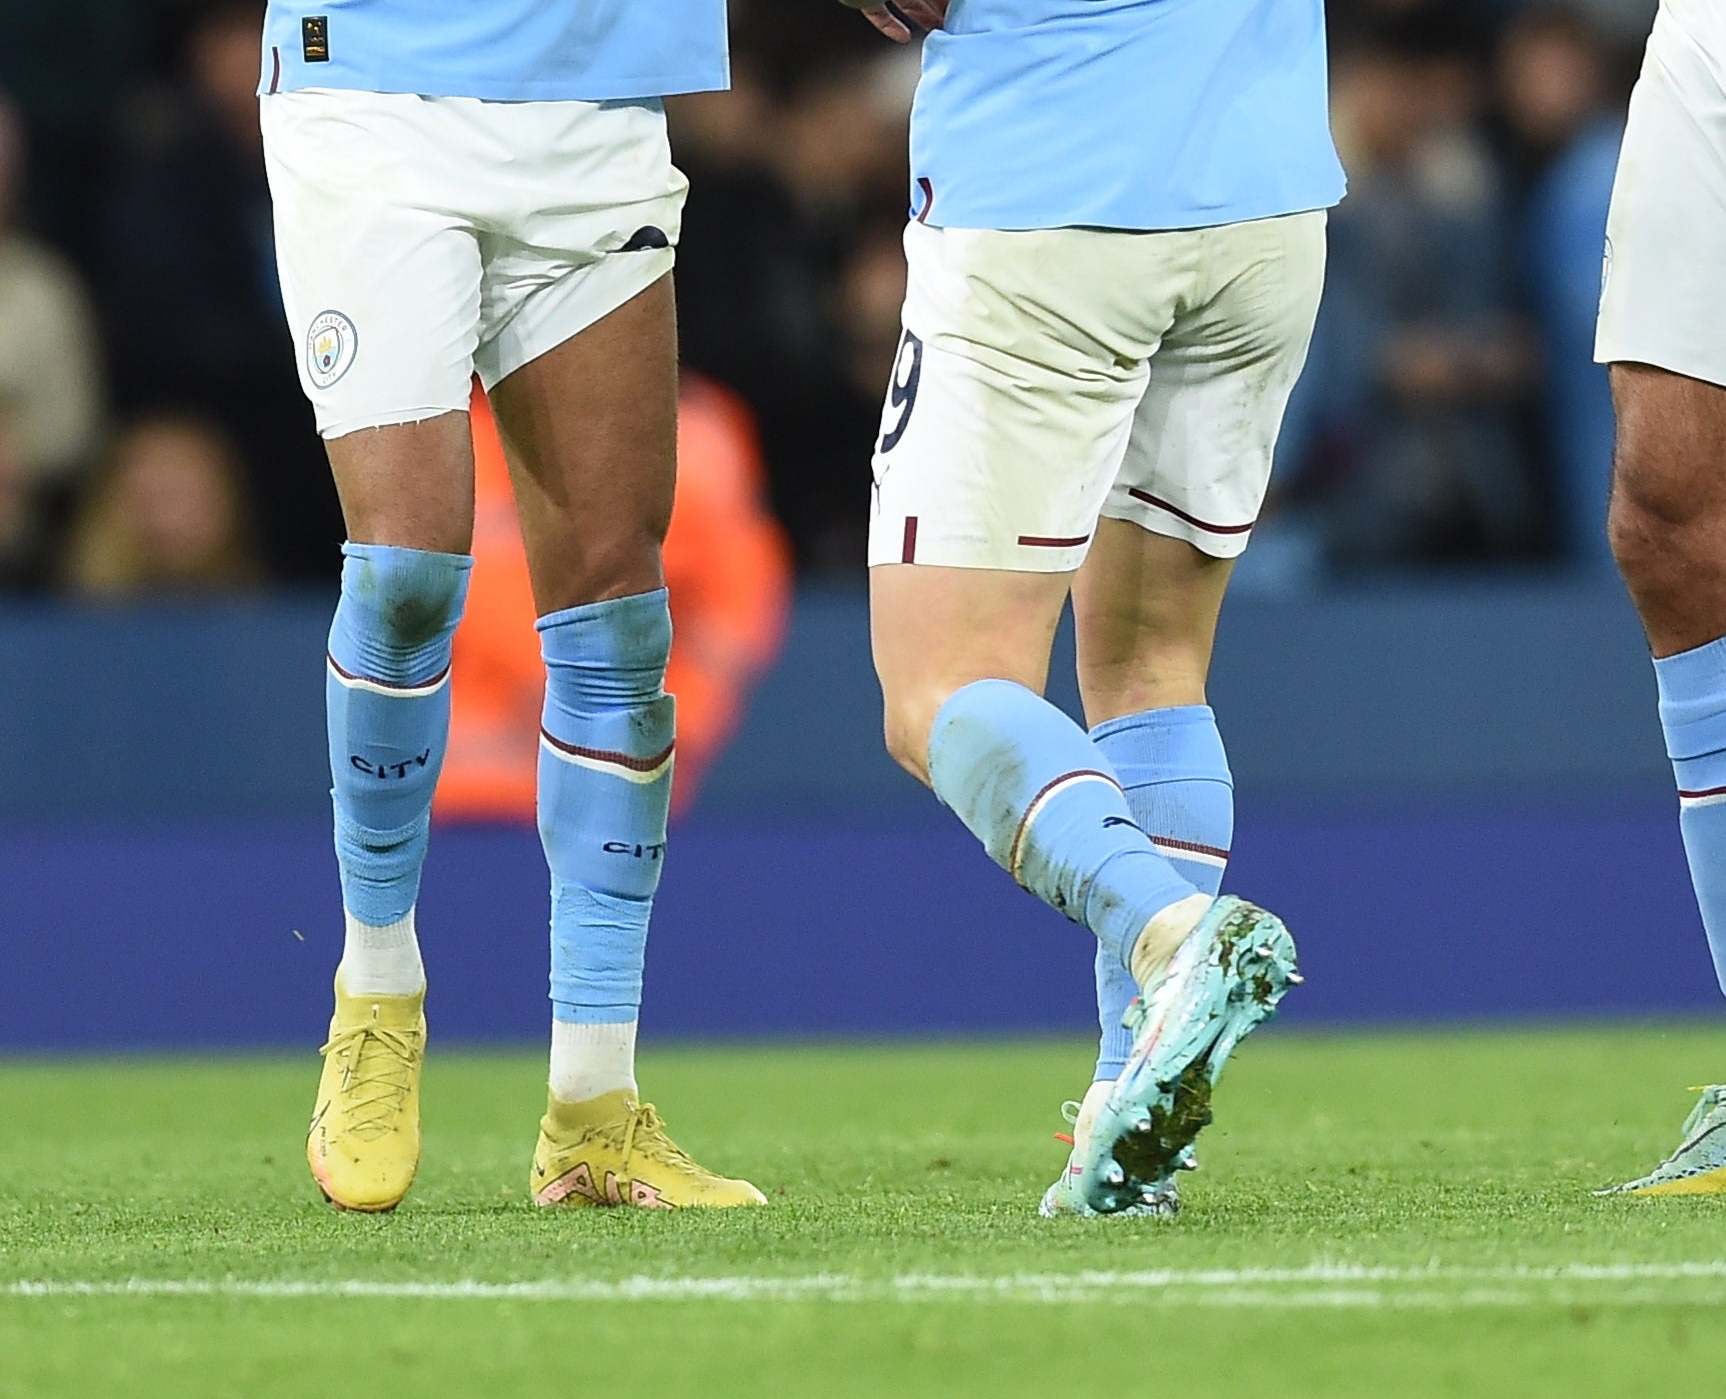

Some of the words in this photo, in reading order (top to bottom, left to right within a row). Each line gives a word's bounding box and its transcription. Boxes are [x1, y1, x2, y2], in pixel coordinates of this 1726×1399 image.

[880, 328, 923, 454] 9
[350, 748, 431, 779] CITY
[603, 842, 665, 860] CIT
